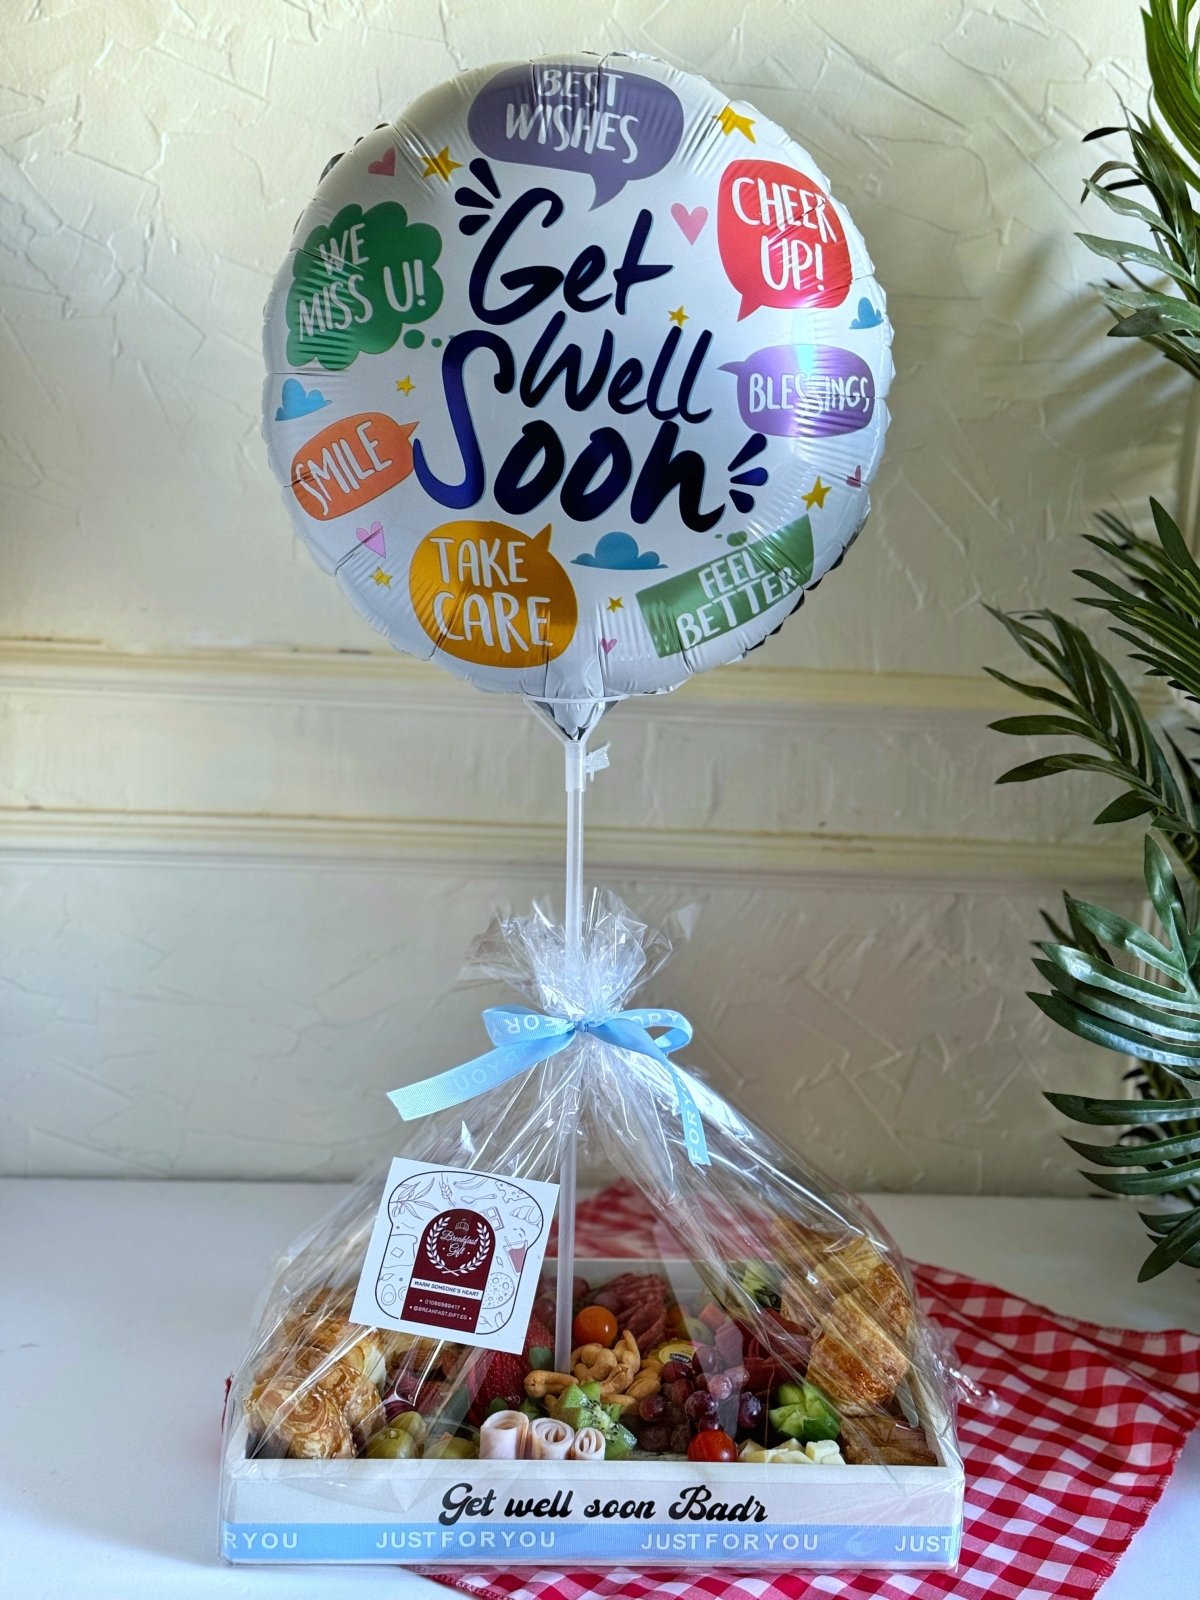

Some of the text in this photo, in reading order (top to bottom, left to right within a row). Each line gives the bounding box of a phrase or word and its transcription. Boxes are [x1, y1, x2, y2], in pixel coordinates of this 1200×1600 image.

[538, 69, 624, 107] BEST
[506, 103, 639, 164] WISHES
[732, 177, 837, 243] CHEER
[319, 223, 370, 276] WE
[469, 187, 674, 326] Get
[761, 236, 825, 291] UP!
[299, 259, 426, 342] MISS U!
[519, 311, 712, 424] Well
[749, 373, 870, 417] BLESSINGS
[413, 330, 726, 532] Soon
[295, 421, 393, 516] SMILE
[430, 538, 528, 588] TAKE
[698, 551, 766, 599] FEEL
[433, 591, 553, 654] CARE
[676, 567, 797, 650] BETTER
[414, 1280, 480, 1297] WARM SOMEONE'S HEART
[439, 1482, 768, 1526] Get well soon Badr
[242, 1532, 298, 1549] YOU
[895, 1535, 953, 1552] JUST
